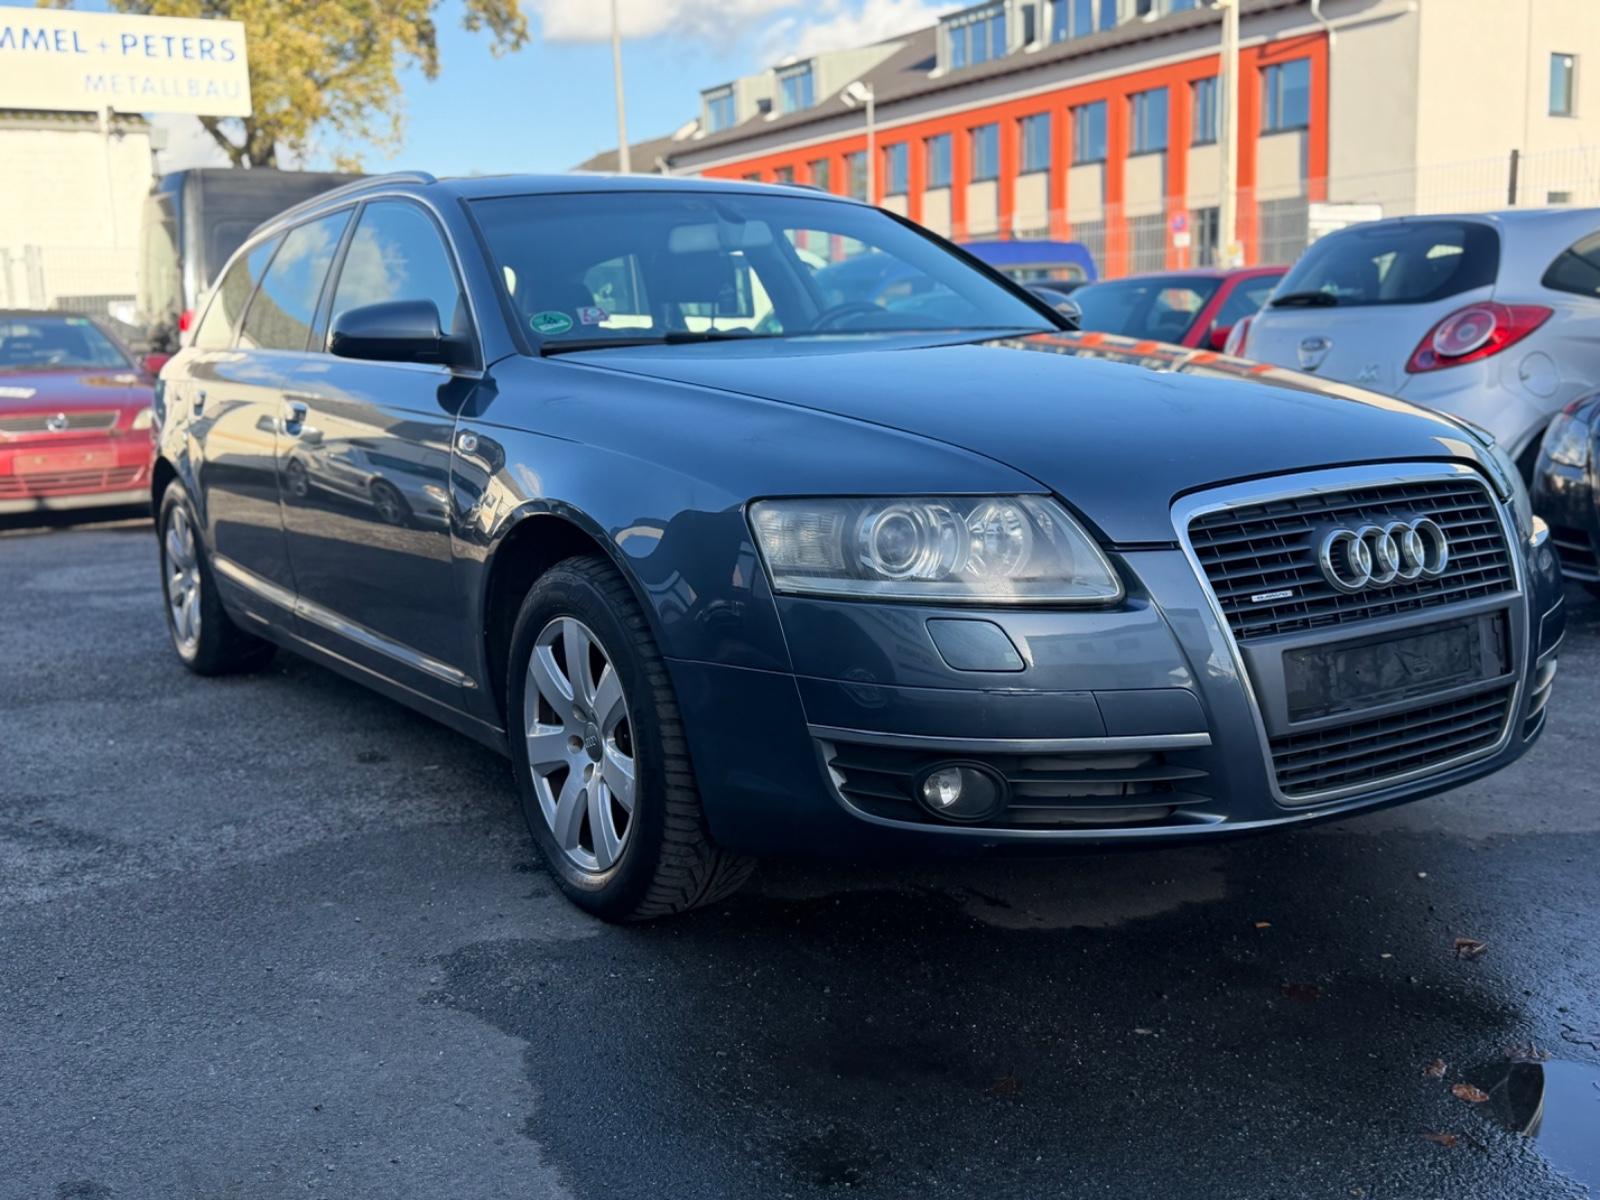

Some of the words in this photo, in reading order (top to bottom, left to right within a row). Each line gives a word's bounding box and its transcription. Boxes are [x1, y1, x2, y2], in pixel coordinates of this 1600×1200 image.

[97, 38, 109, 53] +
[120, 33, 236, 62] PETERS
[84, 74, 241, 99] METALLBAU
